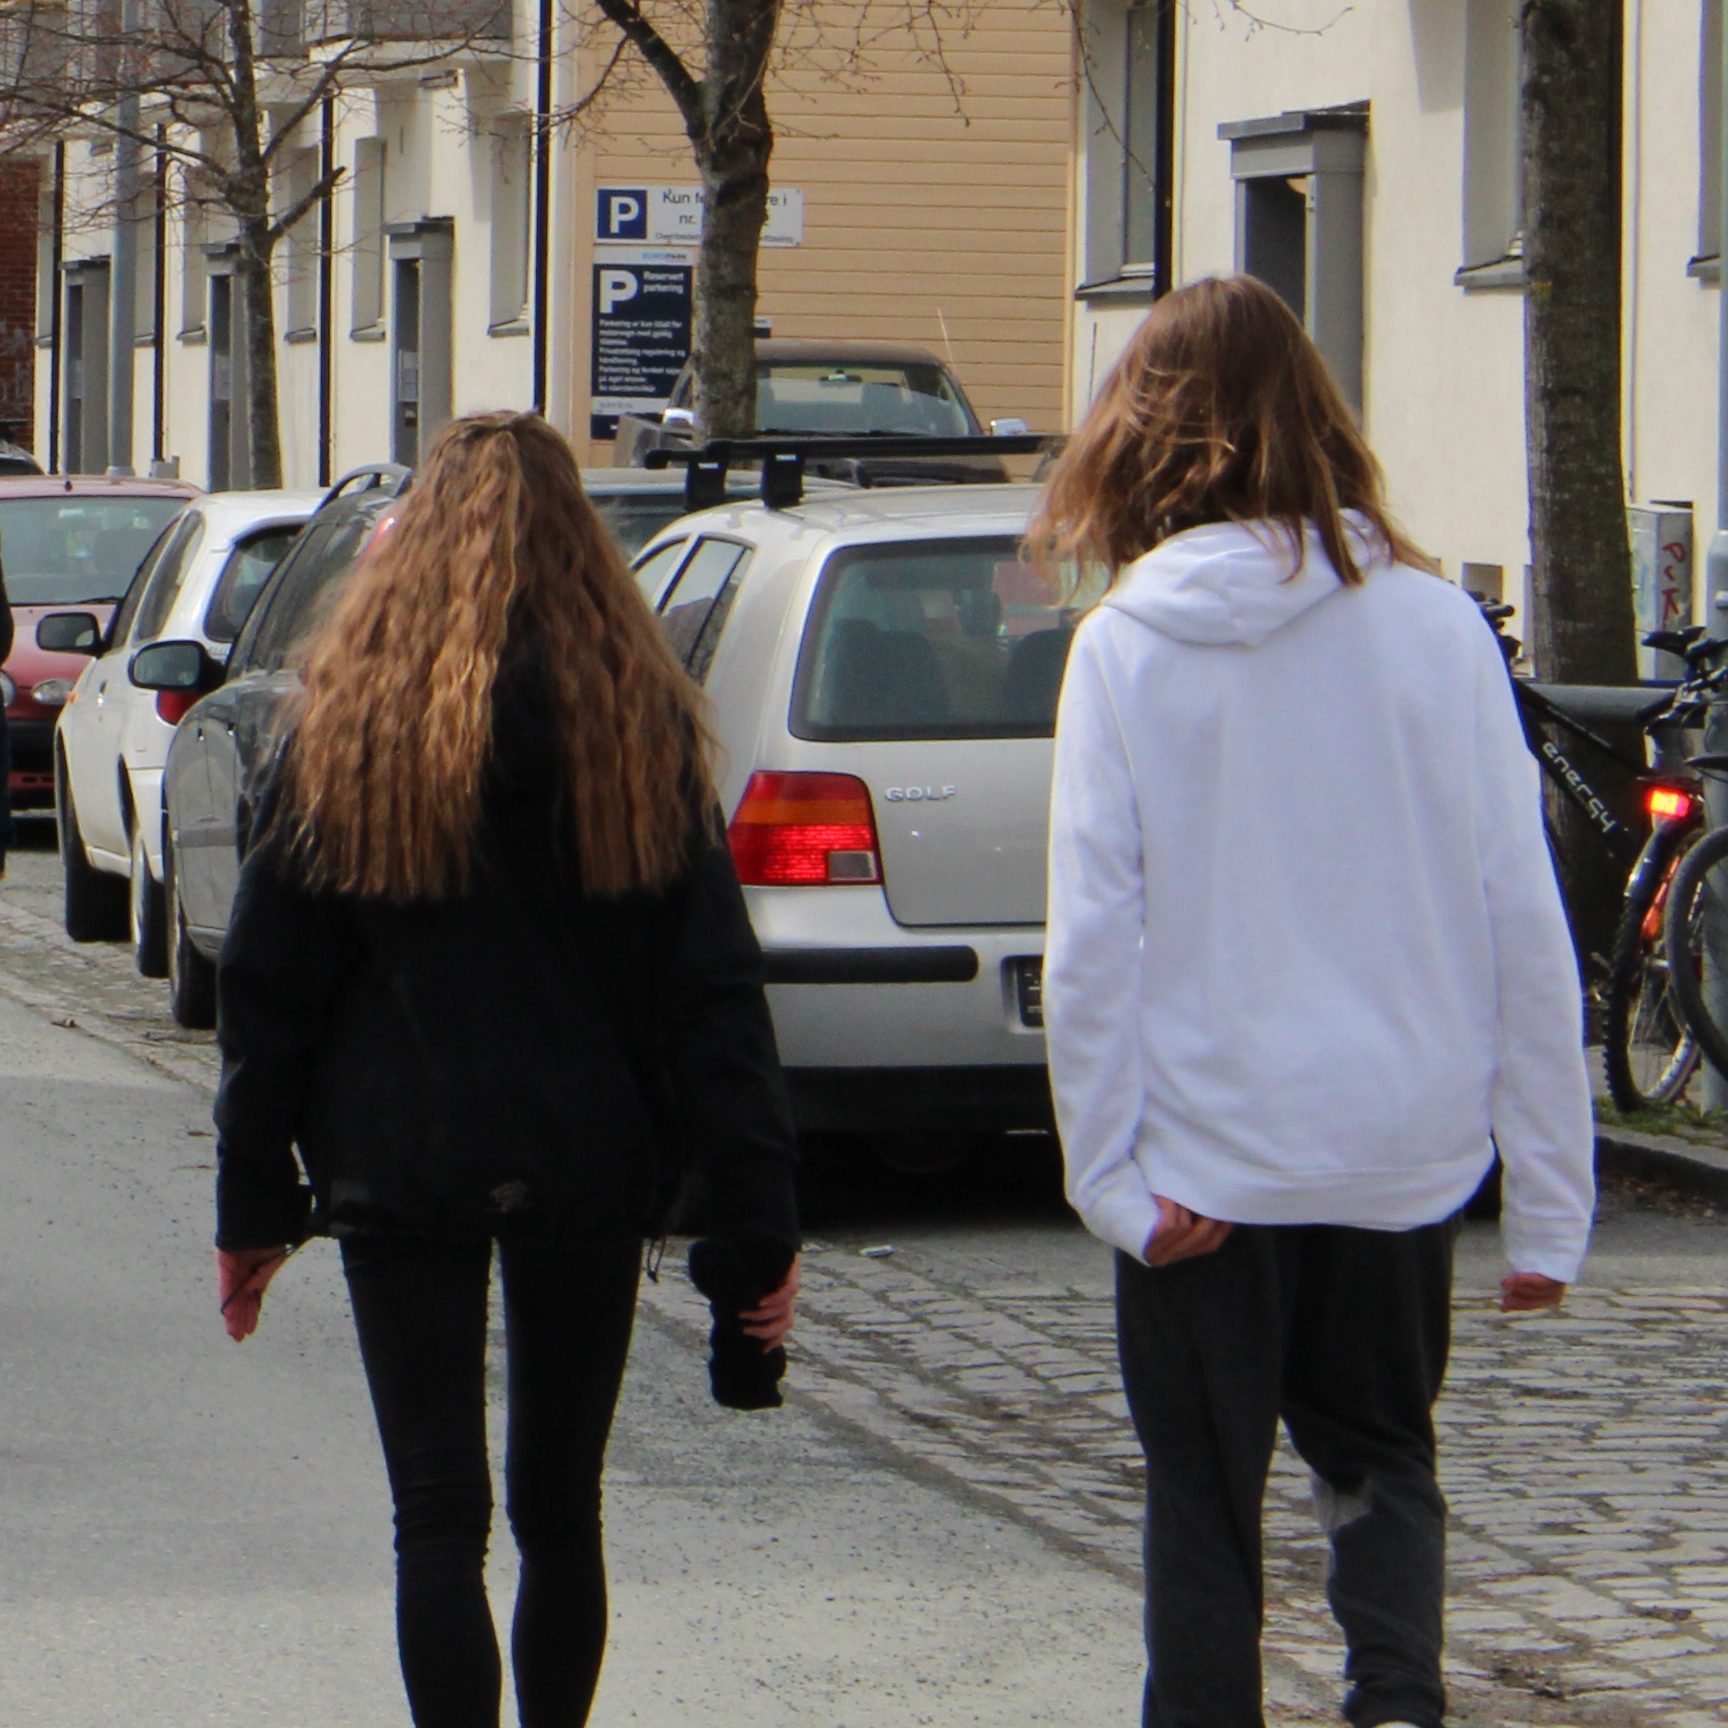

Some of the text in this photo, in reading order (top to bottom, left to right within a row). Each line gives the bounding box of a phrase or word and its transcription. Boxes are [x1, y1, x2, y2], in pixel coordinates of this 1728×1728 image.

[662, 190, 690, 204] Kun
[609, 196, 640, 234] P
[599, 269, 639, 314] P
[884, 784, 957, 802] GOLF
